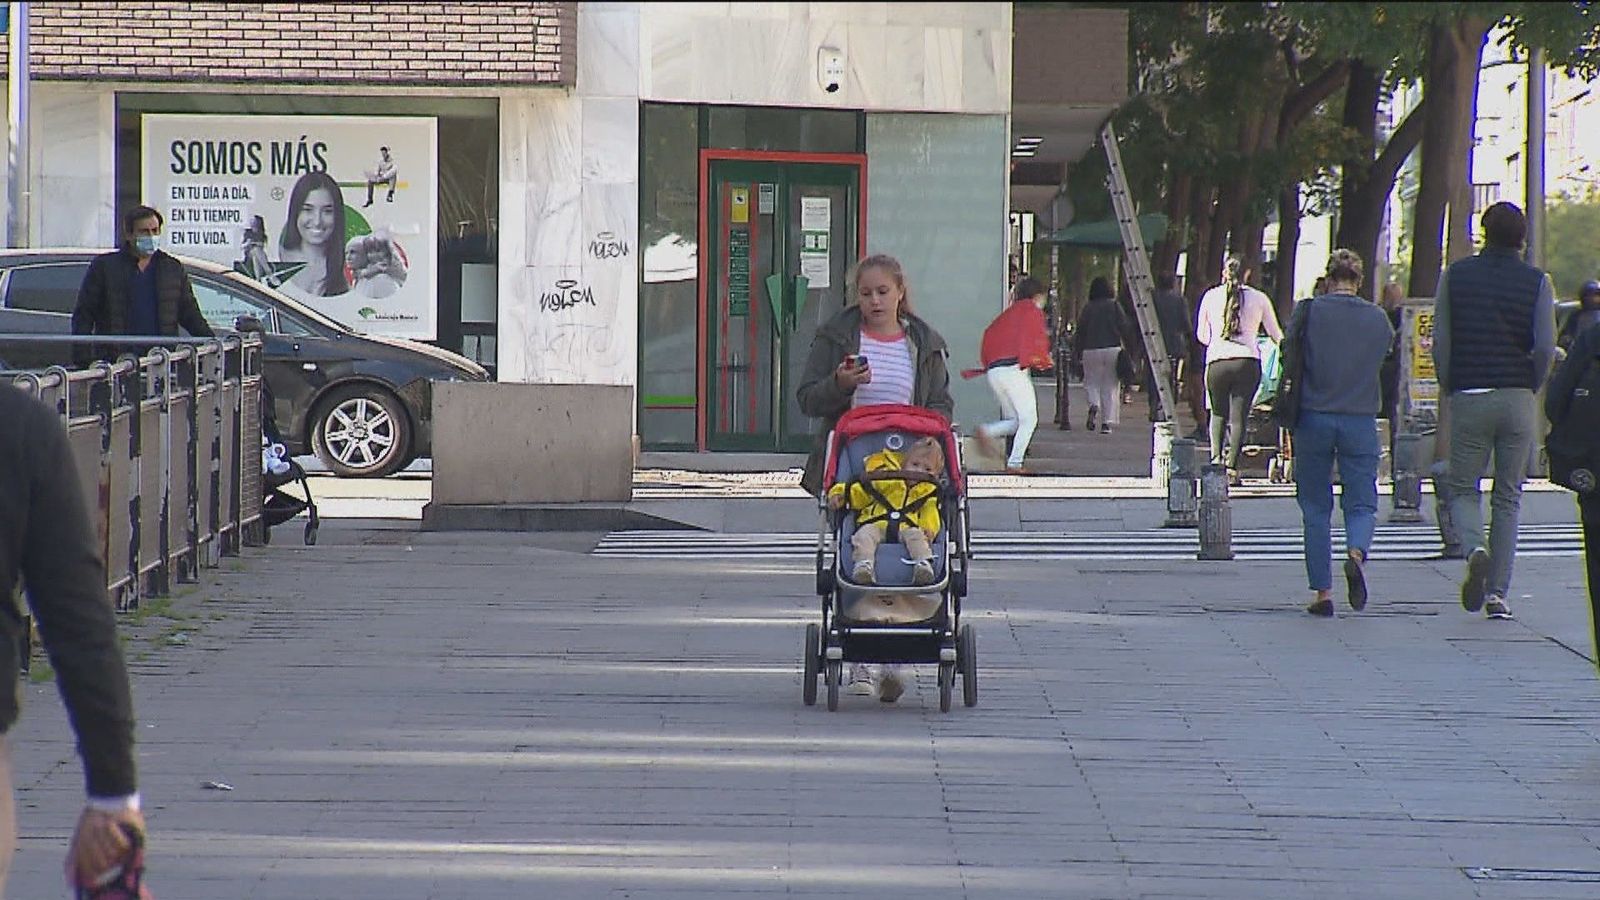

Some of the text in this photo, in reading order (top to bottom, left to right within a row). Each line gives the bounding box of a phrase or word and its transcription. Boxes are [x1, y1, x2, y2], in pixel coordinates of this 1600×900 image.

[170, 135, 328, 175] SOMOS MÁS
[171, 185, 252, 200] EN TU DÍA A DÍA.
[171, 208, 243, 223] EN TU TIEMPO.
[171, 231, 230, 245] EN TU VIDA.
